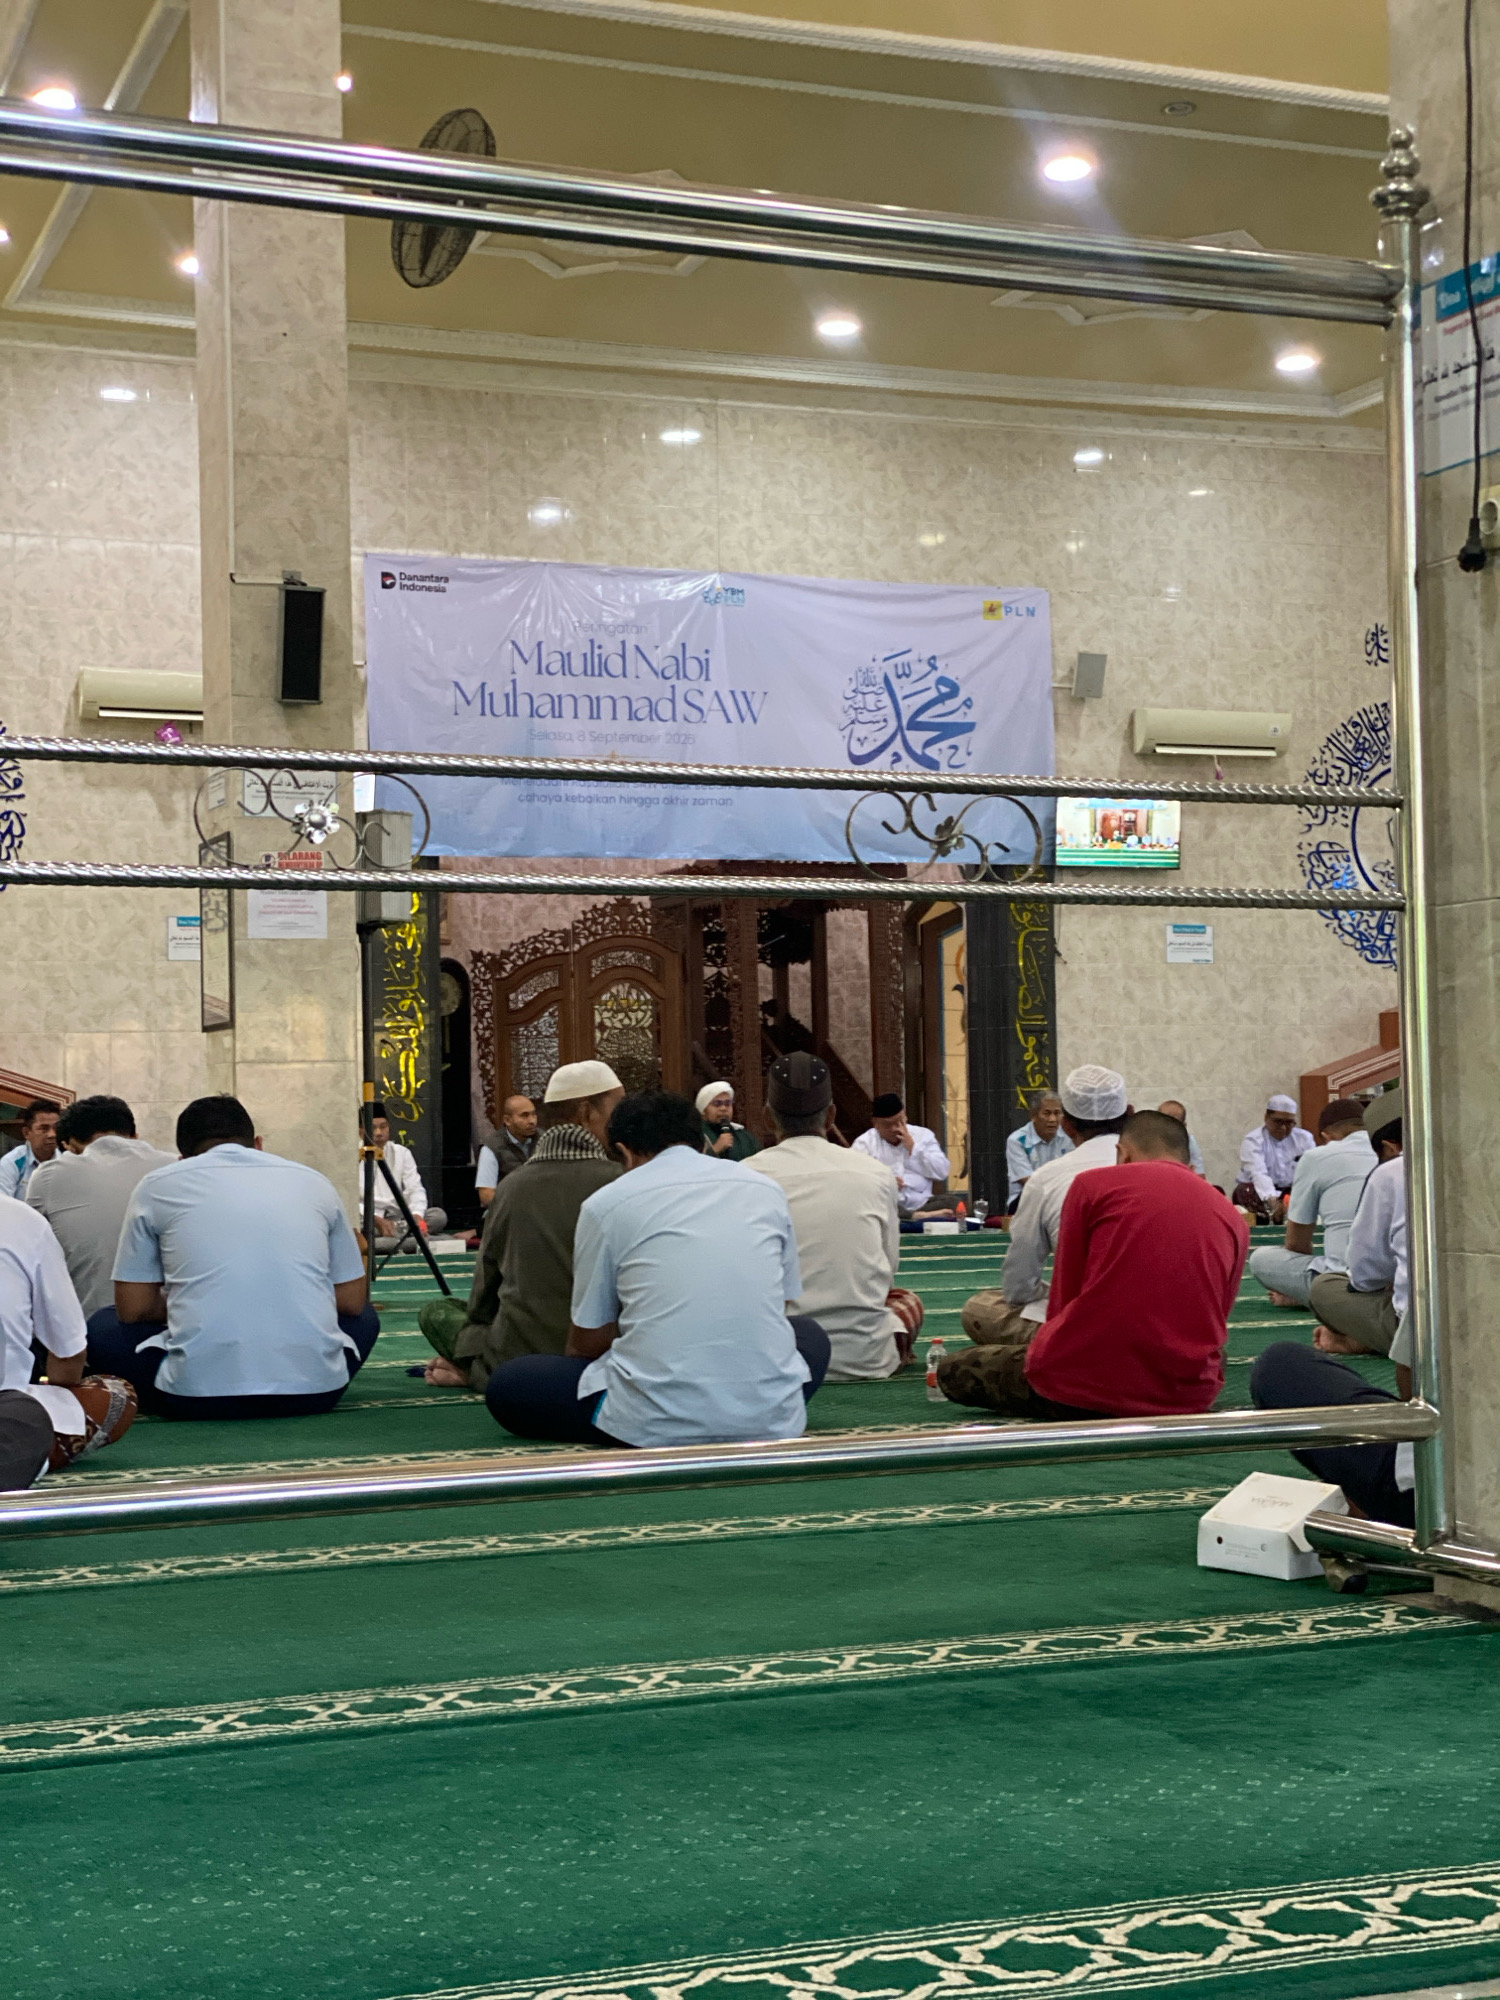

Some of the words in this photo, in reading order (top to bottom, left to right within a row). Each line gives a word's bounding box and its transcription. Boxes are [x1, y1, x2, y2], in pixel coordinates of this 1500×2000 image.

[399, 572, 450, 584] Danantara
[399, 582, 447, 593] Indonesia
[1004, 605, 1036, 617] PLN
[510, 638, 628, 679] Maulid
[633, 642, 712, 682] Nabi
[452, 678, 678, 723] Muhammad
[683, 688, 769, 725] SAW
[589, 730, 661, 745] September
[518, 792, 562, 805] cahaya
[565, 793, 616, 804] kebaikan
[620, 795, 660, 808] hingga
[663, 796, 689, 806] akhir
[692, 797, 733, 807] zaman
[277, 851, 323, 860] DLARANG
